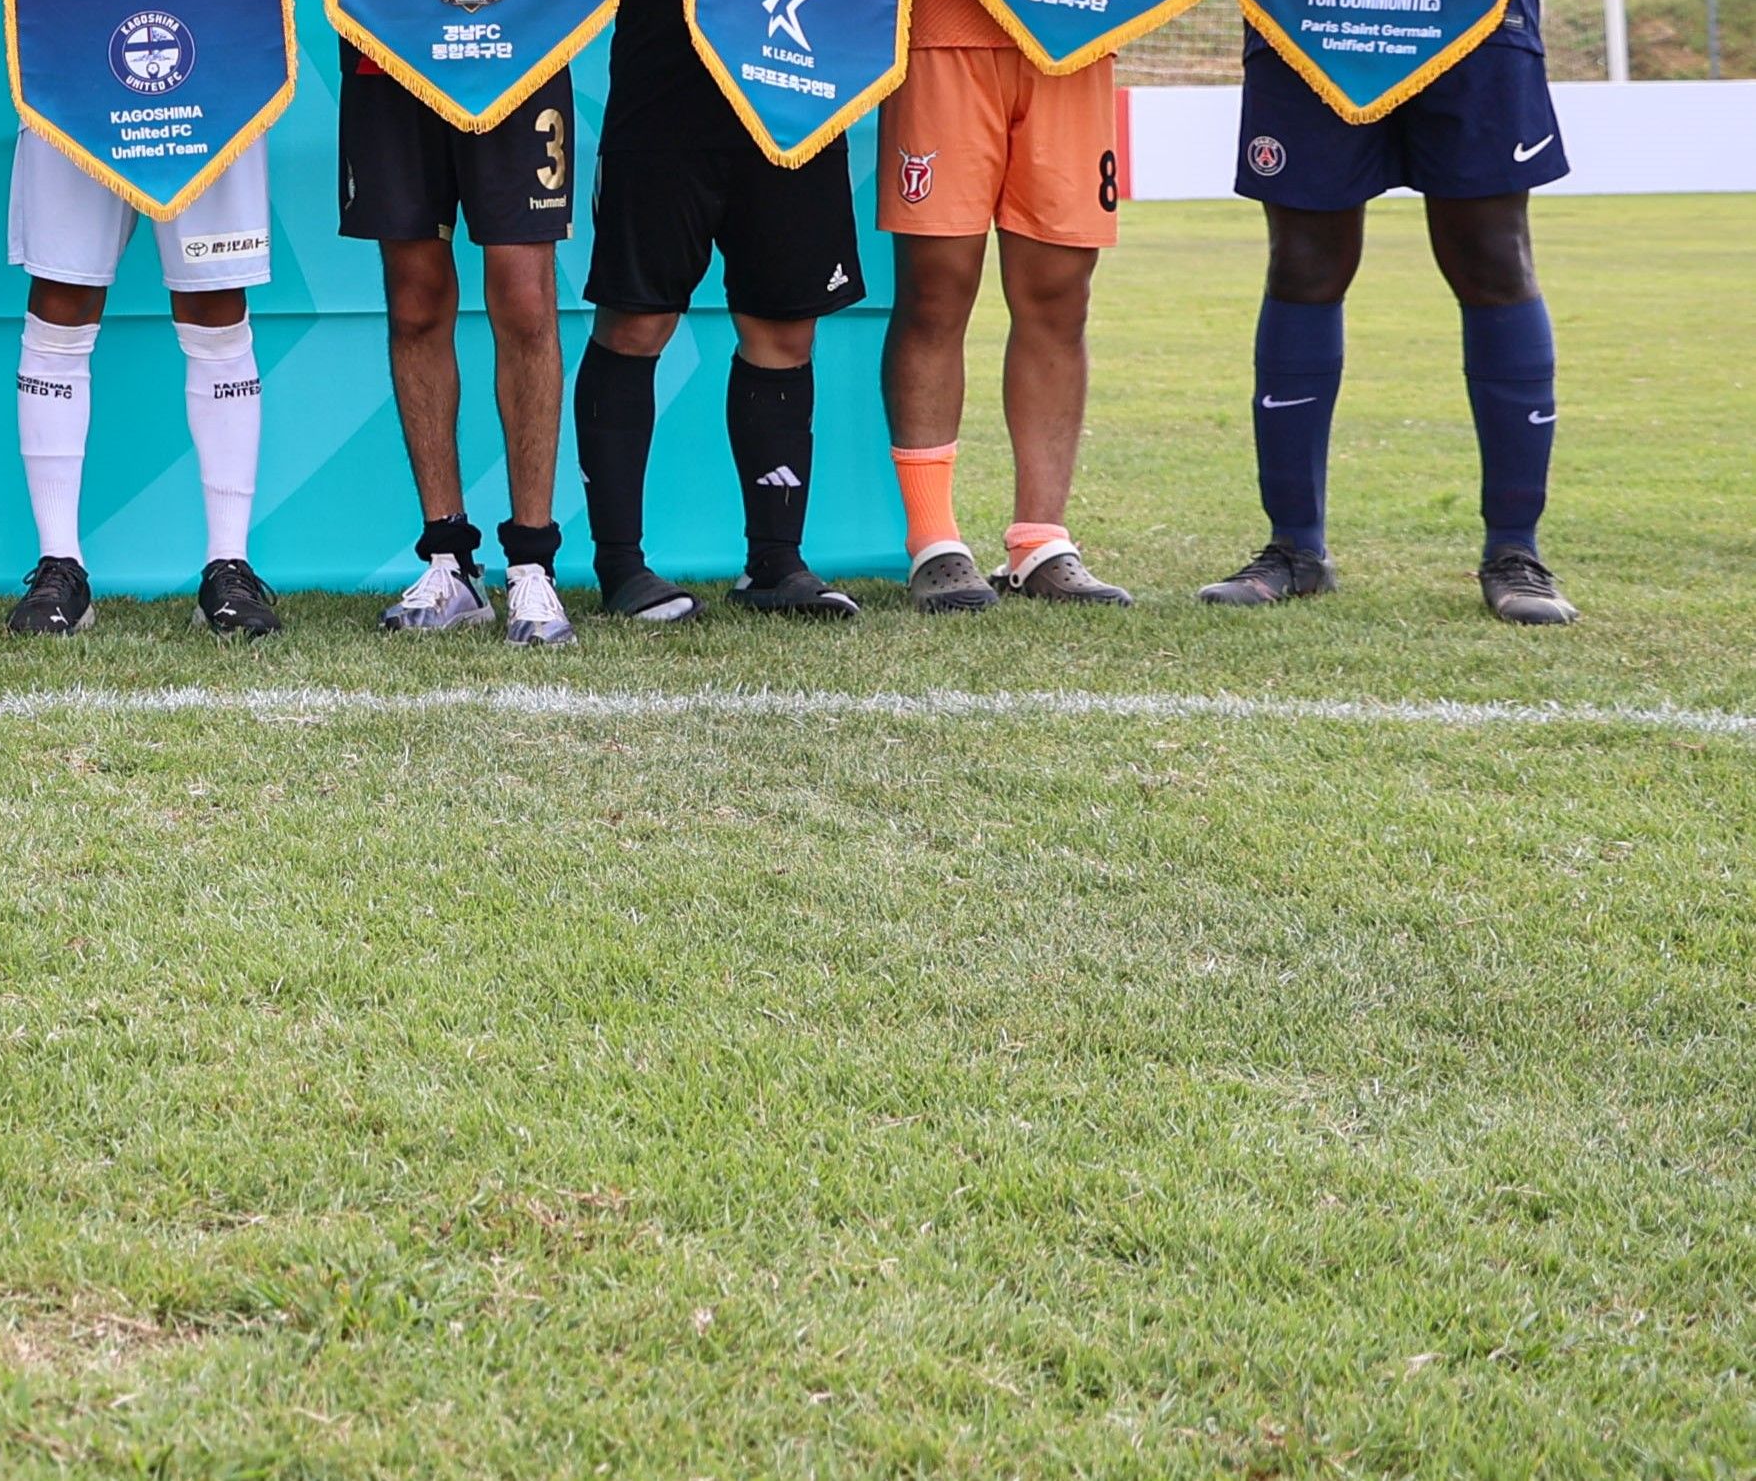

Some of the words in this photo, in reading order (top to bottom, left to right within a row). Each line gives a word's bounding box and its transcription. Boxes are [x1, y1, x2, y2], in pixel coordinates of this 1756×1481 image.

[120, 14, 180, 34] KAGOSHIMA
[442, 24, 500, 41] 경남FC
[1301, 20, 1342, 34] Paris
[1345, 22, 1380, 36] Saint
[1382, 23, 1441, 38] Germain
[432, 43, 513, 60] 통합축구단
[1323, 38, 1375, 53] Unified
[1378, 39, 1416, 55] Team
[762, 46, 773, 58] K
[775, 47, 814, 68] LEAGUE
[125, 76, 166, 92] UNITED
[167, 73, 183, 87] FC
[742, 63, 836, 99] 한국프로축구연맹
[111, 106, 203, 124] KAGOSHIMA
[122, 126, 169, 141] United
[172, 125, 192, 138] FC
[112, 145, 164, 160] Unified
[166, 143, 207, 157] Team
[535, 108, 566, 190] 3
[1098, 149, 1117, 212] 8
[529, 195, 567, 210] hummel
